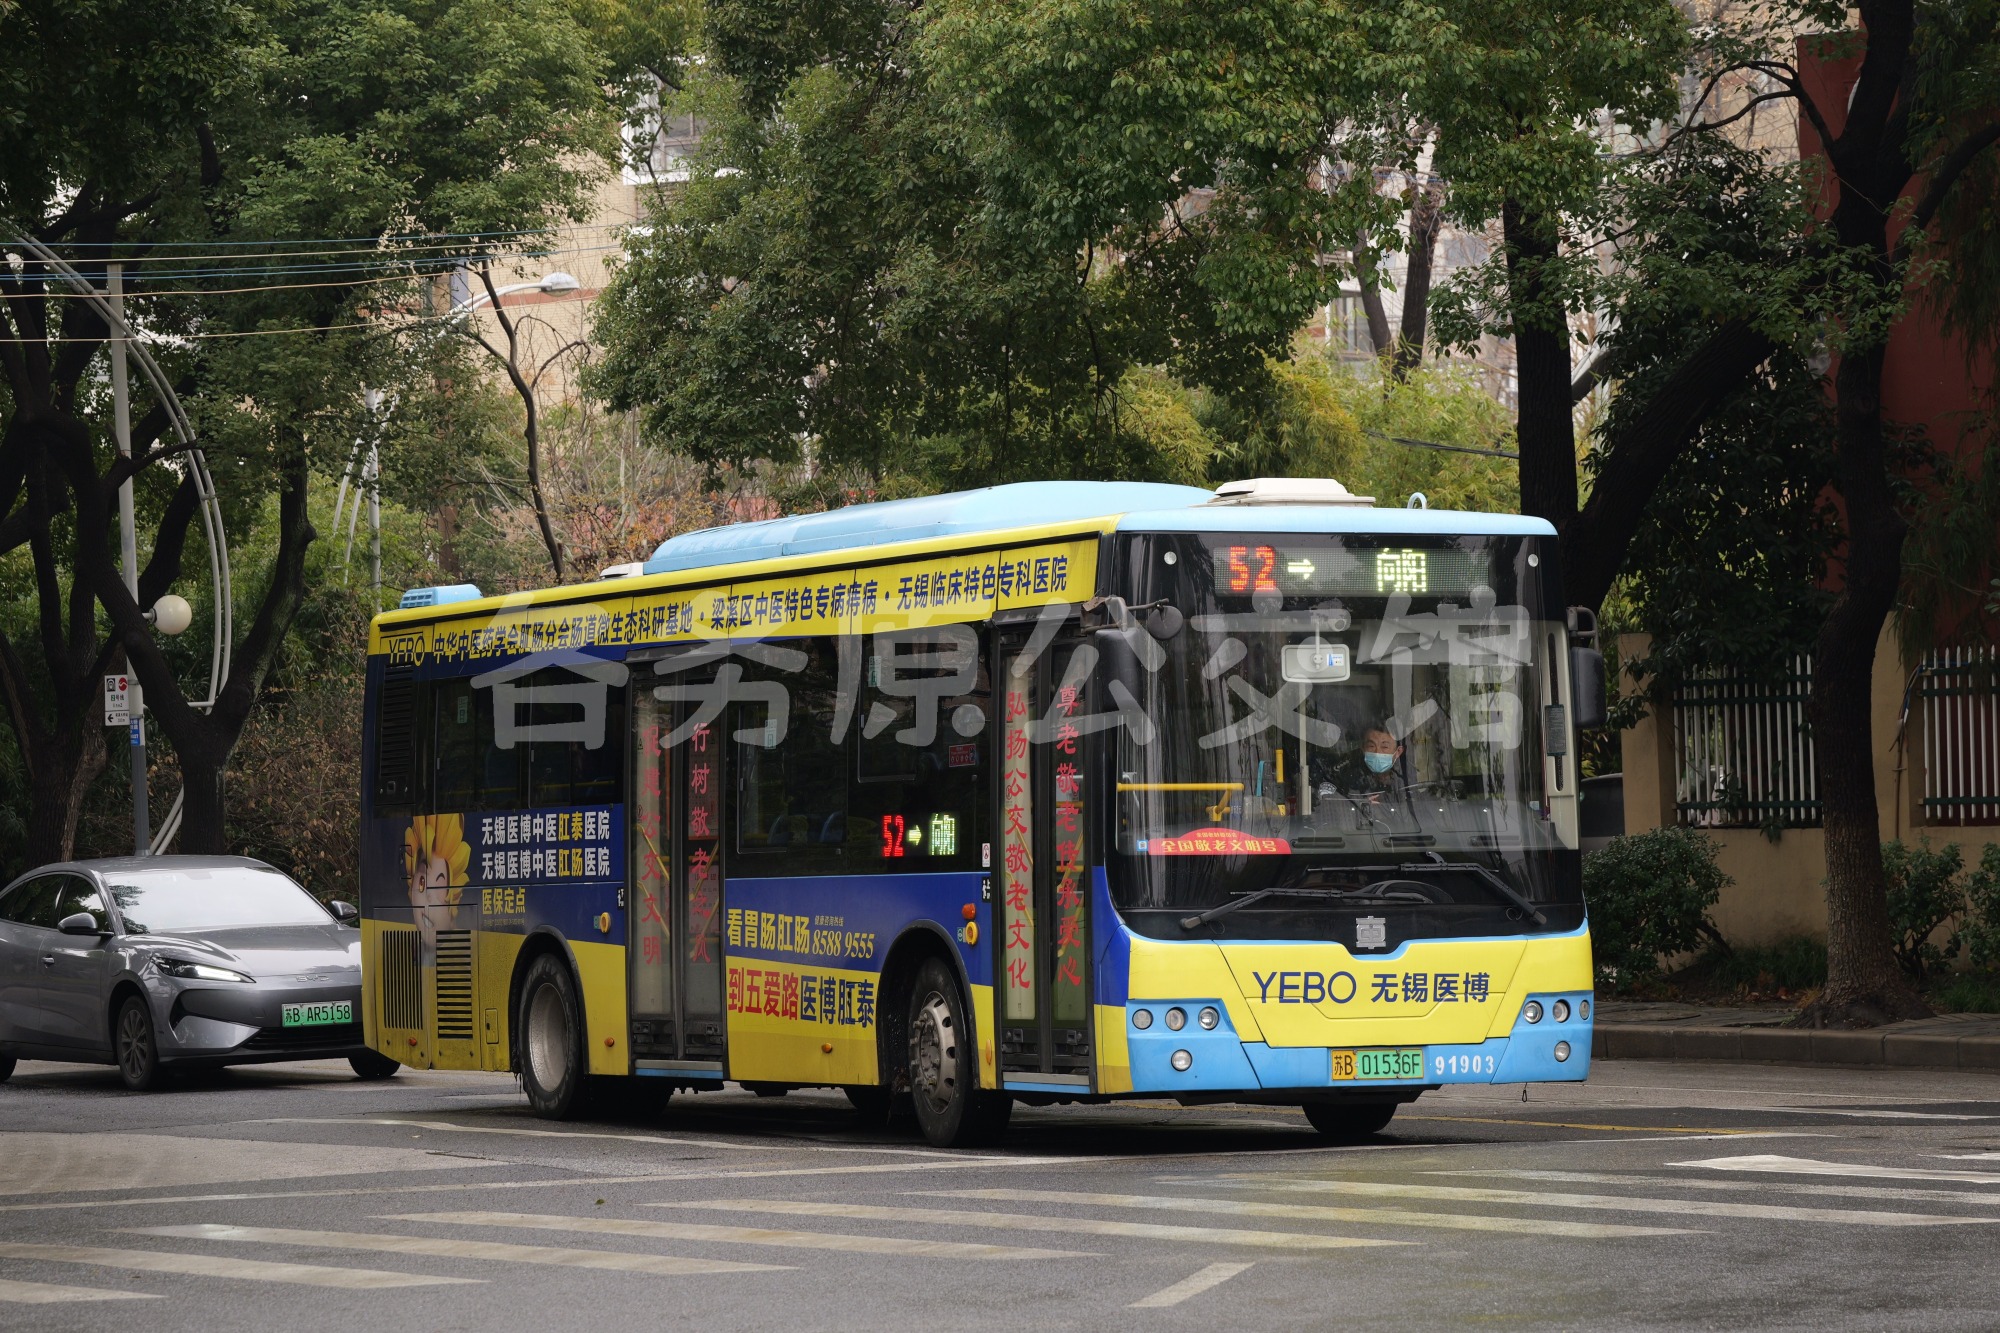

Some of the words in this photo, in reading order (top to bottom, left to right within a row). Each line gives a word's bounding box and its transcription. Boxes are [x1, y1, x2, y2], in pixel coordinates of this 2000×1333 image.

[1229, 546, 1276, 591] 52
[1377, 549, 1426, 592] 向阳
[481, 810, 610, 846] 无锡医博中医肛泰医院
[883, 815, 904, 857] 52
[931, 813, 955, 856] 向阳
[1004, 692, 1030, 989] 弘扬公交敬老文化
[1160, 839, 1278, 852] 全国敬老文明号
[481, 846, 610, 881] 无锡医博中医肛肠医院
[481, 887, 526, 915] 医保定点
[727, 908, 810, 955] 看胃肠肛肠
[812, 929, 842, 956] 8588
[844, 931, 876, 959] 9555
[727, 967, 875, 1028] 到五爱路医博肛泰
[1252, 970, 1357, 1004] YEBO
[1370, 971, 1491, 1003] 无锡医博
[1434, 1055, 1495, 1075] 91903
